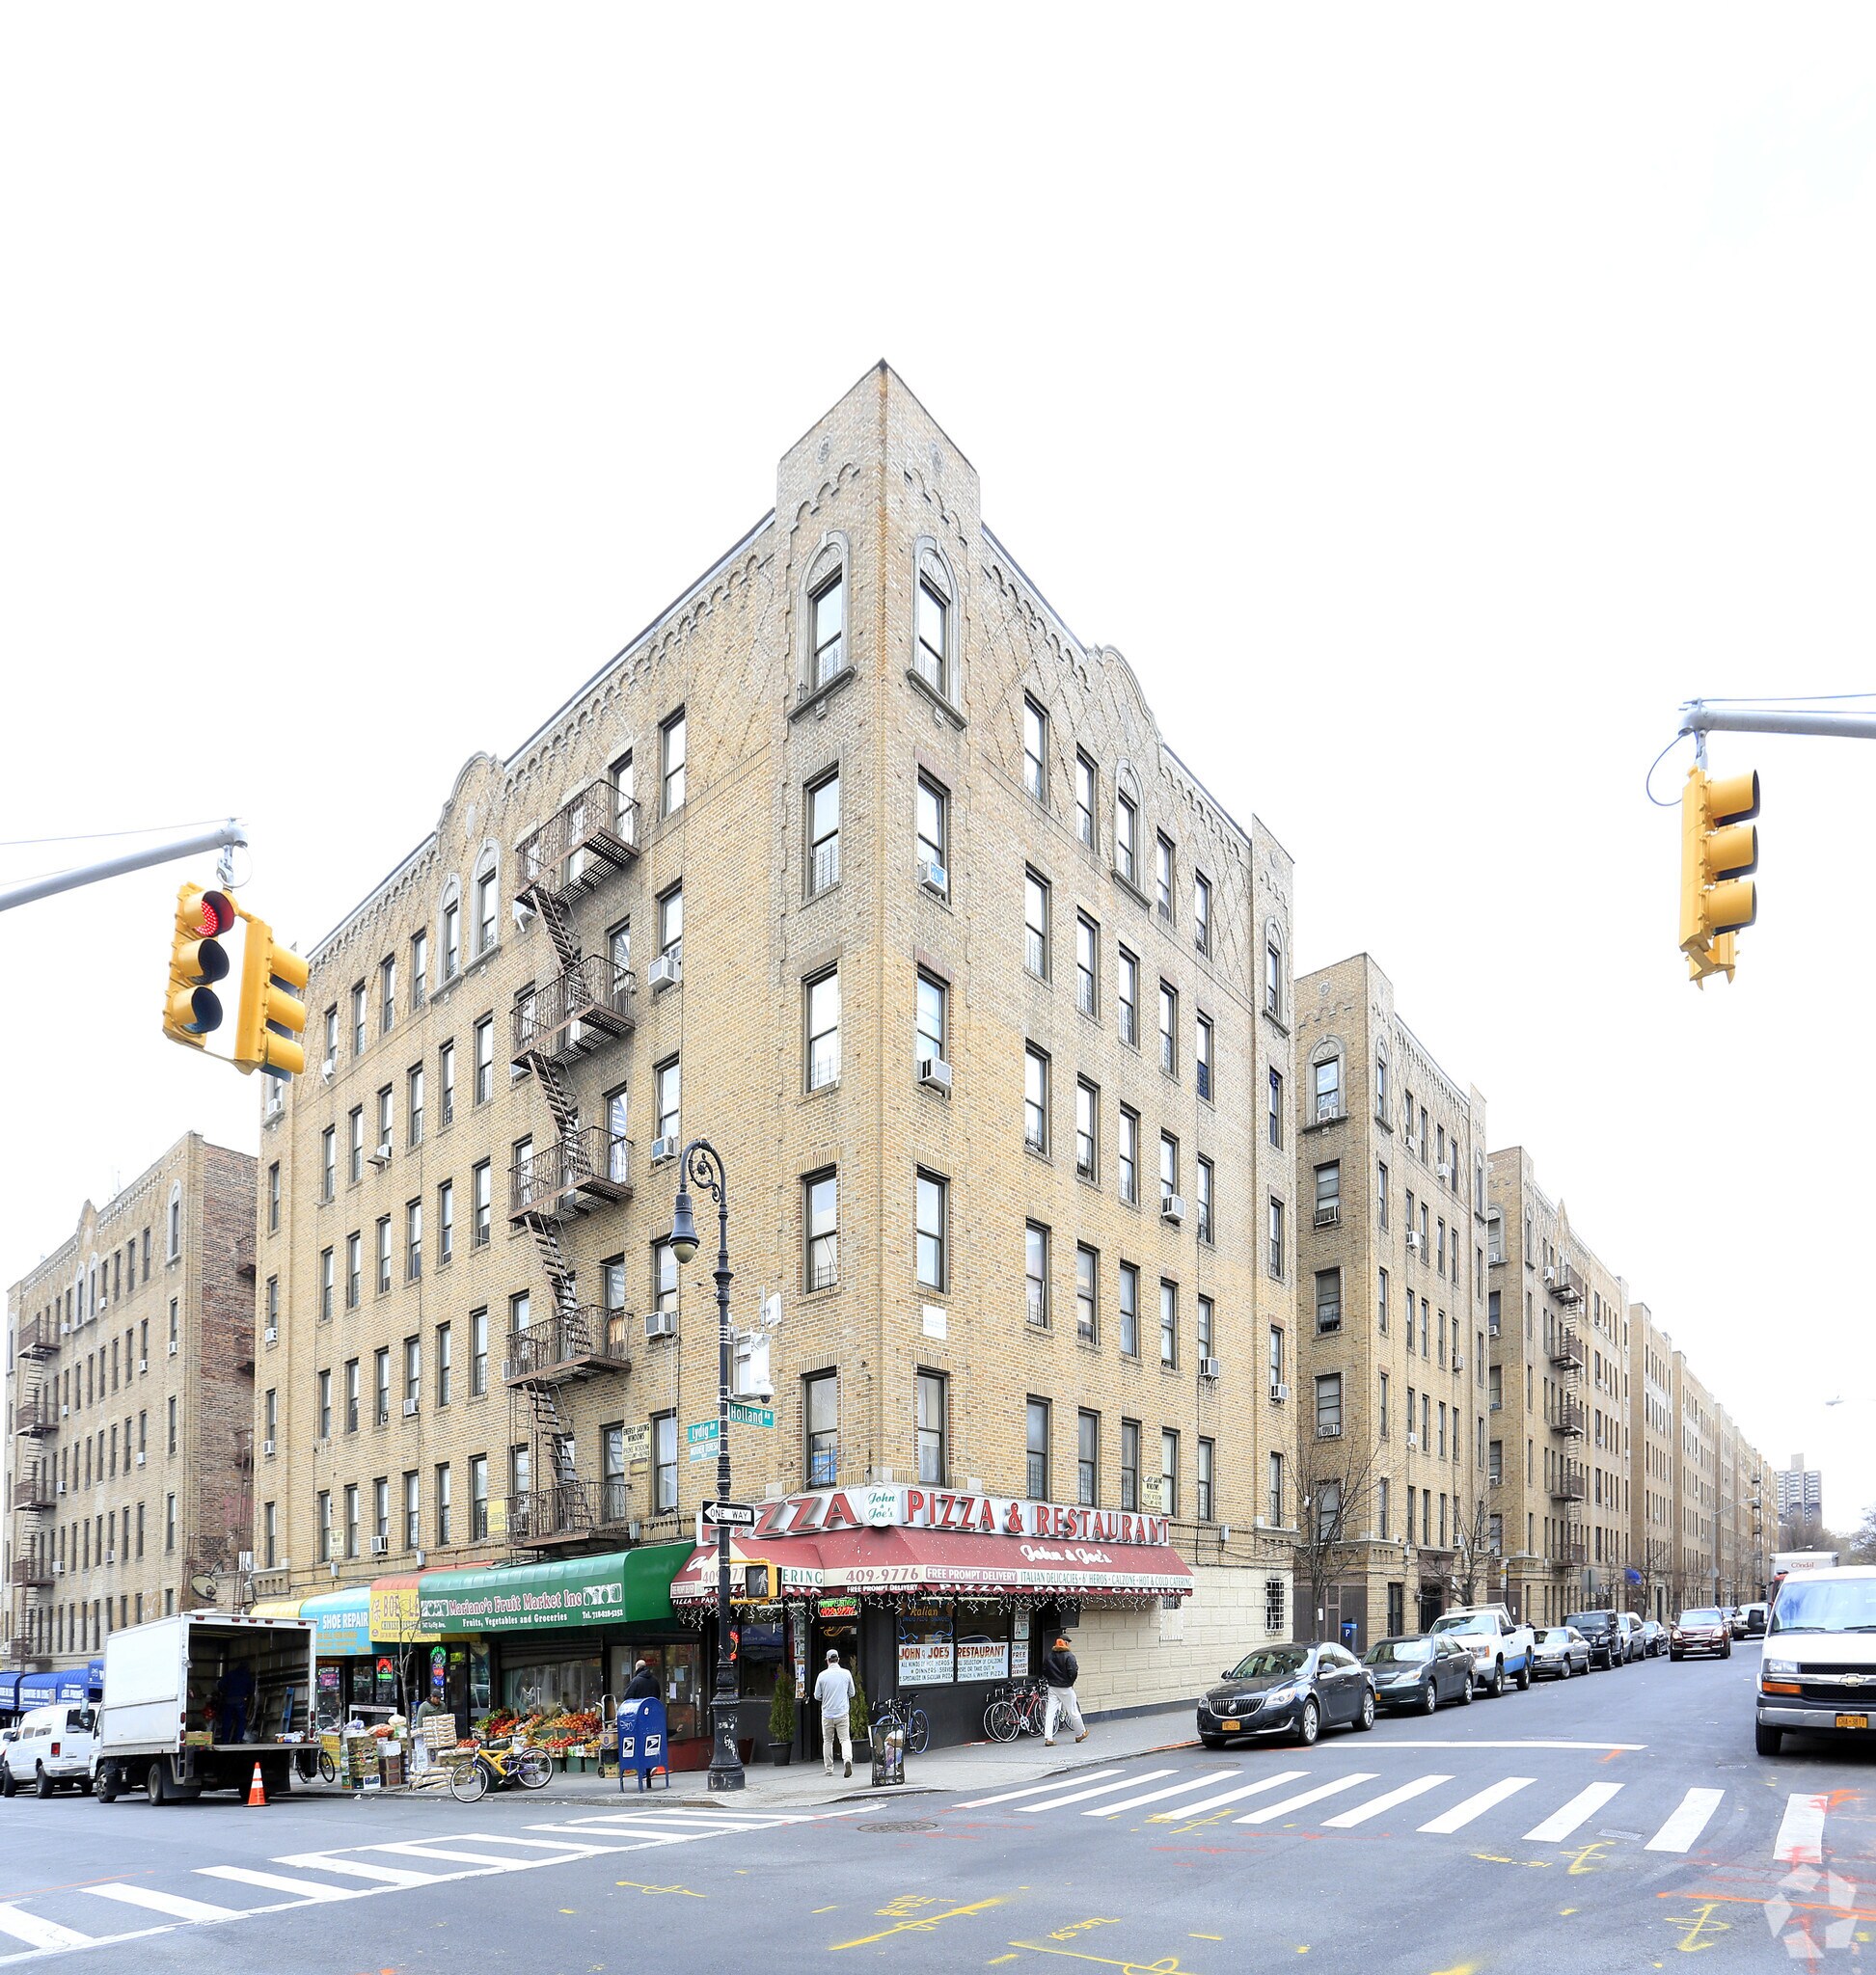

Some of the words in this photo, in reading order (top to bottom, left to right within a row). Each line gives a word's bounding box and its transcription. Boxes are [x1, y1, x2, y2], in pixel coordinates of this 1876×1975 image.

[730, 1405, 763, 1424] Holland
[623, 1427, 636, 1436] ENERGY
[637, 1423, 649, 1433] SAVING
[692, 1425, 709, 1440] Lydig
[628, 1433, 644, 1443] WINDOWS
[868, 1492, 895, 1504] John
[710, 1508, 725, 1519] ONE
[732, 1510, 748, 1520] WAY
[868, 1507, 894, 1520] Joe's
[907, 1490, 995, 1530] PIZZA
[1008, 1502, 1024, 1532] &
[1036, 1506, 1169, 1543] RESTAURANT
[1020, 1545, 1065, 1562] John
[1075, 1548, 1113, 1565] Joe's
[846, 1567, 919, 1583] 409-9776
[927, 1568, 947, 1579] FREE
[948, 1570, 981, 1581] PROMPT
[982, 1571, 1017, 1582] DELIVERY
[1020, 1571, 1046, 1583] ITALIAN
[1047, 1572, 1078, 1584] DELICACIES
[1089, 1574, 1107, 1584] HEROS
[1112, 1575, 1135, 1585] CALZONE
[1139, 1575, 1150, 1585] HOT
[1151, 1576, 1155, 1585] &
[1155, 1576, 1169, 1586] COLD
[1170, 1576, 1192, 1587] CATERING
[939, 1583, 1005, 1592] PIZZA
[449, 1598, 492, 1616] Mariano's
[494, 1594, 521, 1611] Fruit
[523, 1591, 561, 1610] Market
[563, 1589, 582, 1607] Inc
[910, 1605, 938, 1616] Italian
[322, 1613, 341, 1630] SHOE
[342, 1611, 368, 1629] REPAIR
[462, 1617, 483, 1628] Fruits,
[484, 1615, 518, 1628] Vegetables
[520, 1614, 531, 1624] and
[534, 1612, 568, 1623] Groceries
[1345, 1629, 1351, 1637] P
[899, 1647, 920, 1660] JOHN
[957, 1645, 1006, 1659] RESTAURANT
